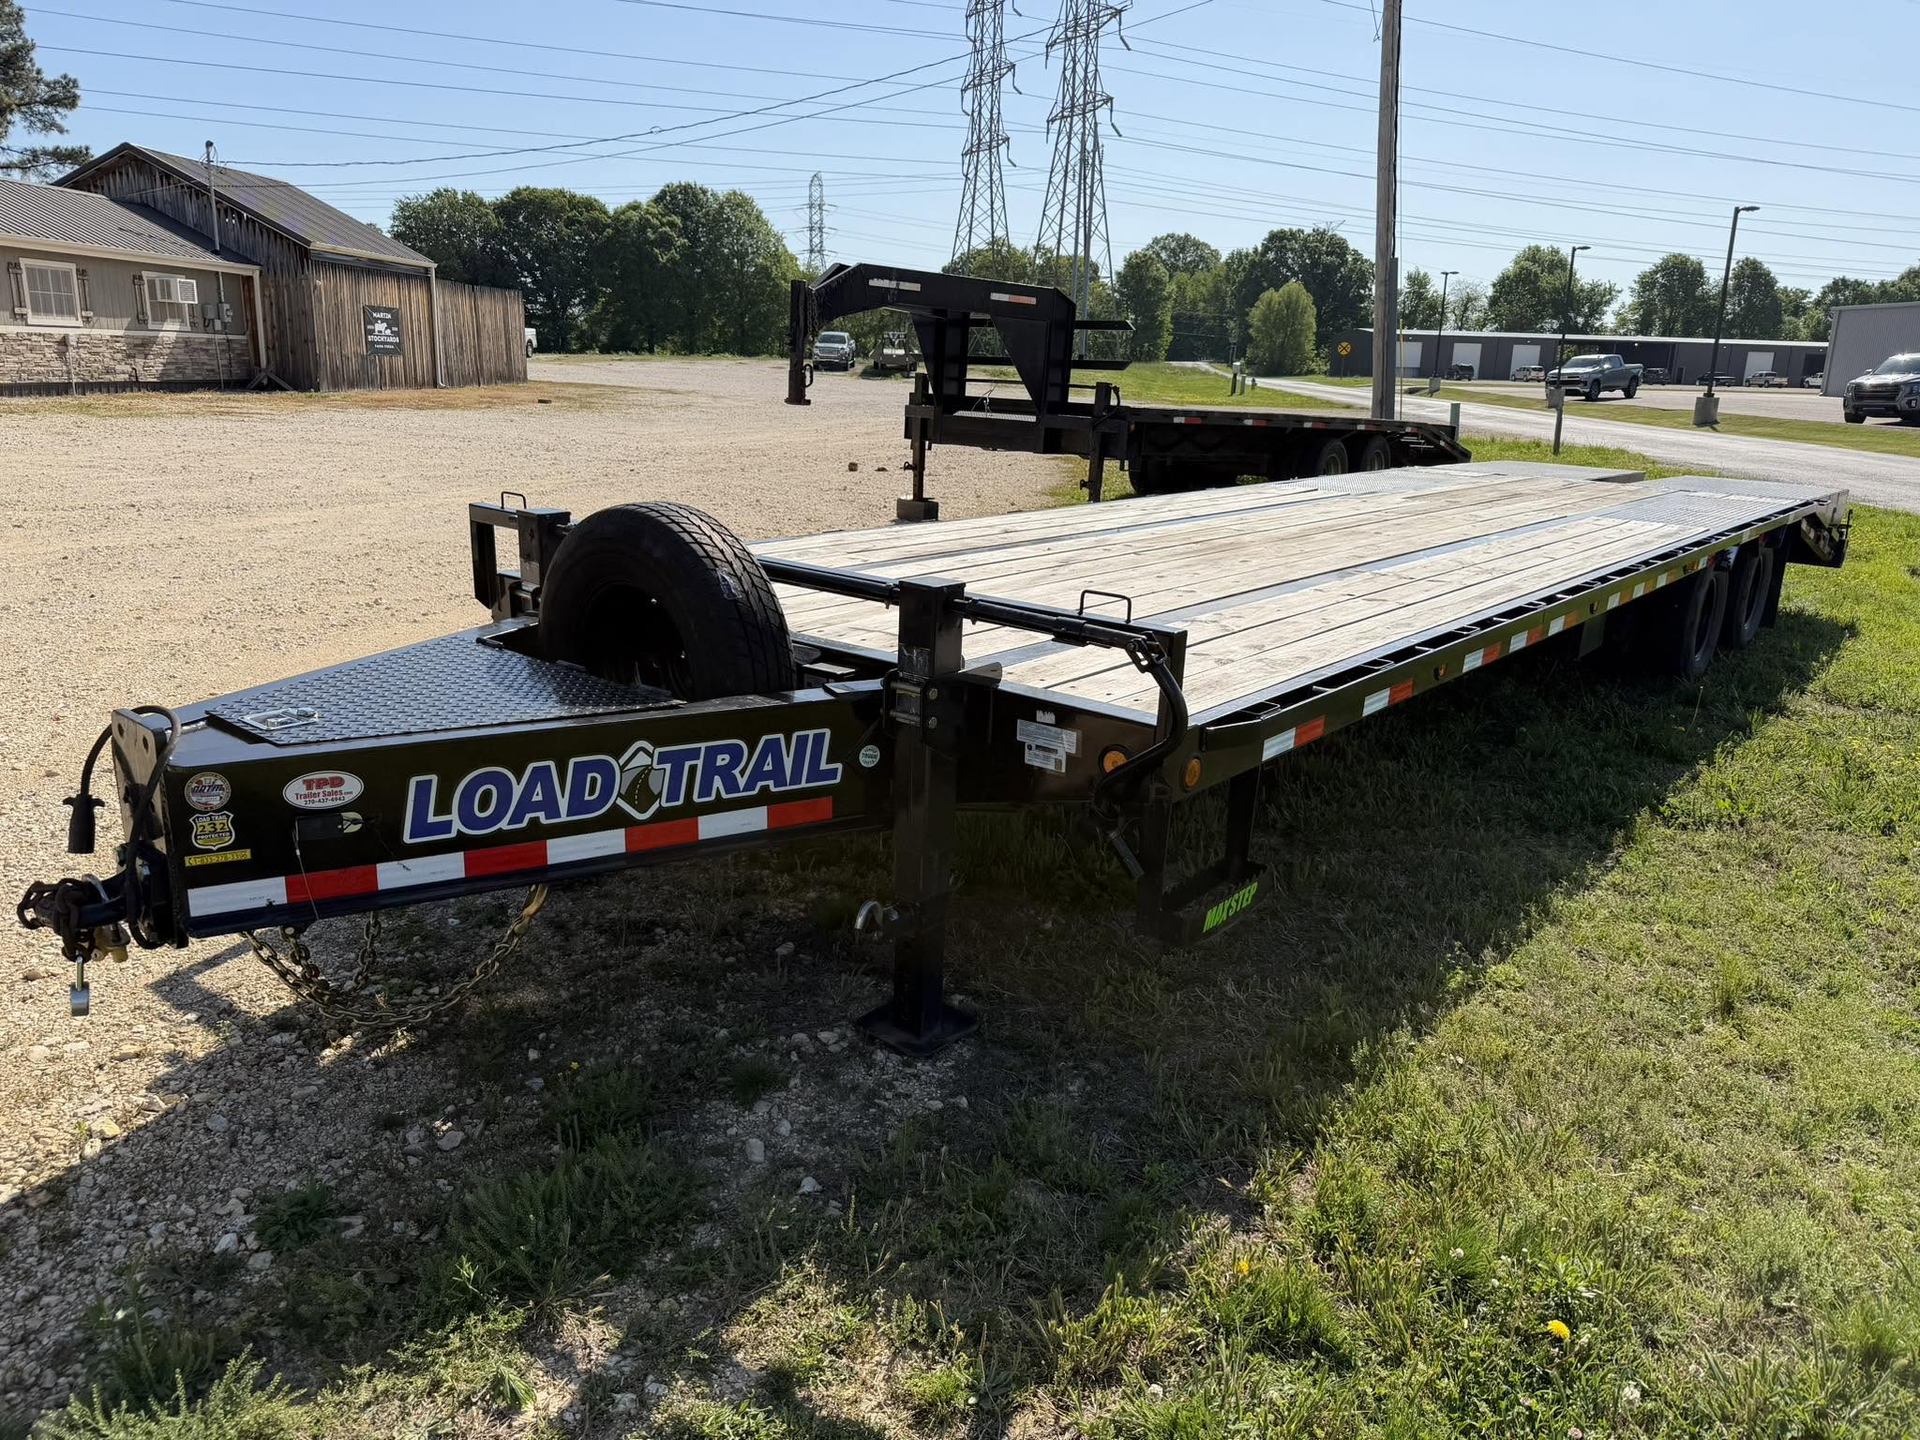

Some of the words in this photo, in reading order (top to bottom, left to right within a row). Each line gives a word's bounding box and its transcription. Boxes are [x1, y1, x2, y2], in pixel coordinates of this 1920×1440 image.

[368, 335, 399, 343] STOCKYARDS
[302, 776, 345, 790] TPD
[403, 754, 621, 844] LOAD
[653, 727, 842, 807] TRAIL
[294, 791, 320, 800] Trailer
[198, 822, 226, 833] 232
[197, 832, 230, 840] PROTECTED
[1203, 881, 1259, 933] MAXSTEP
